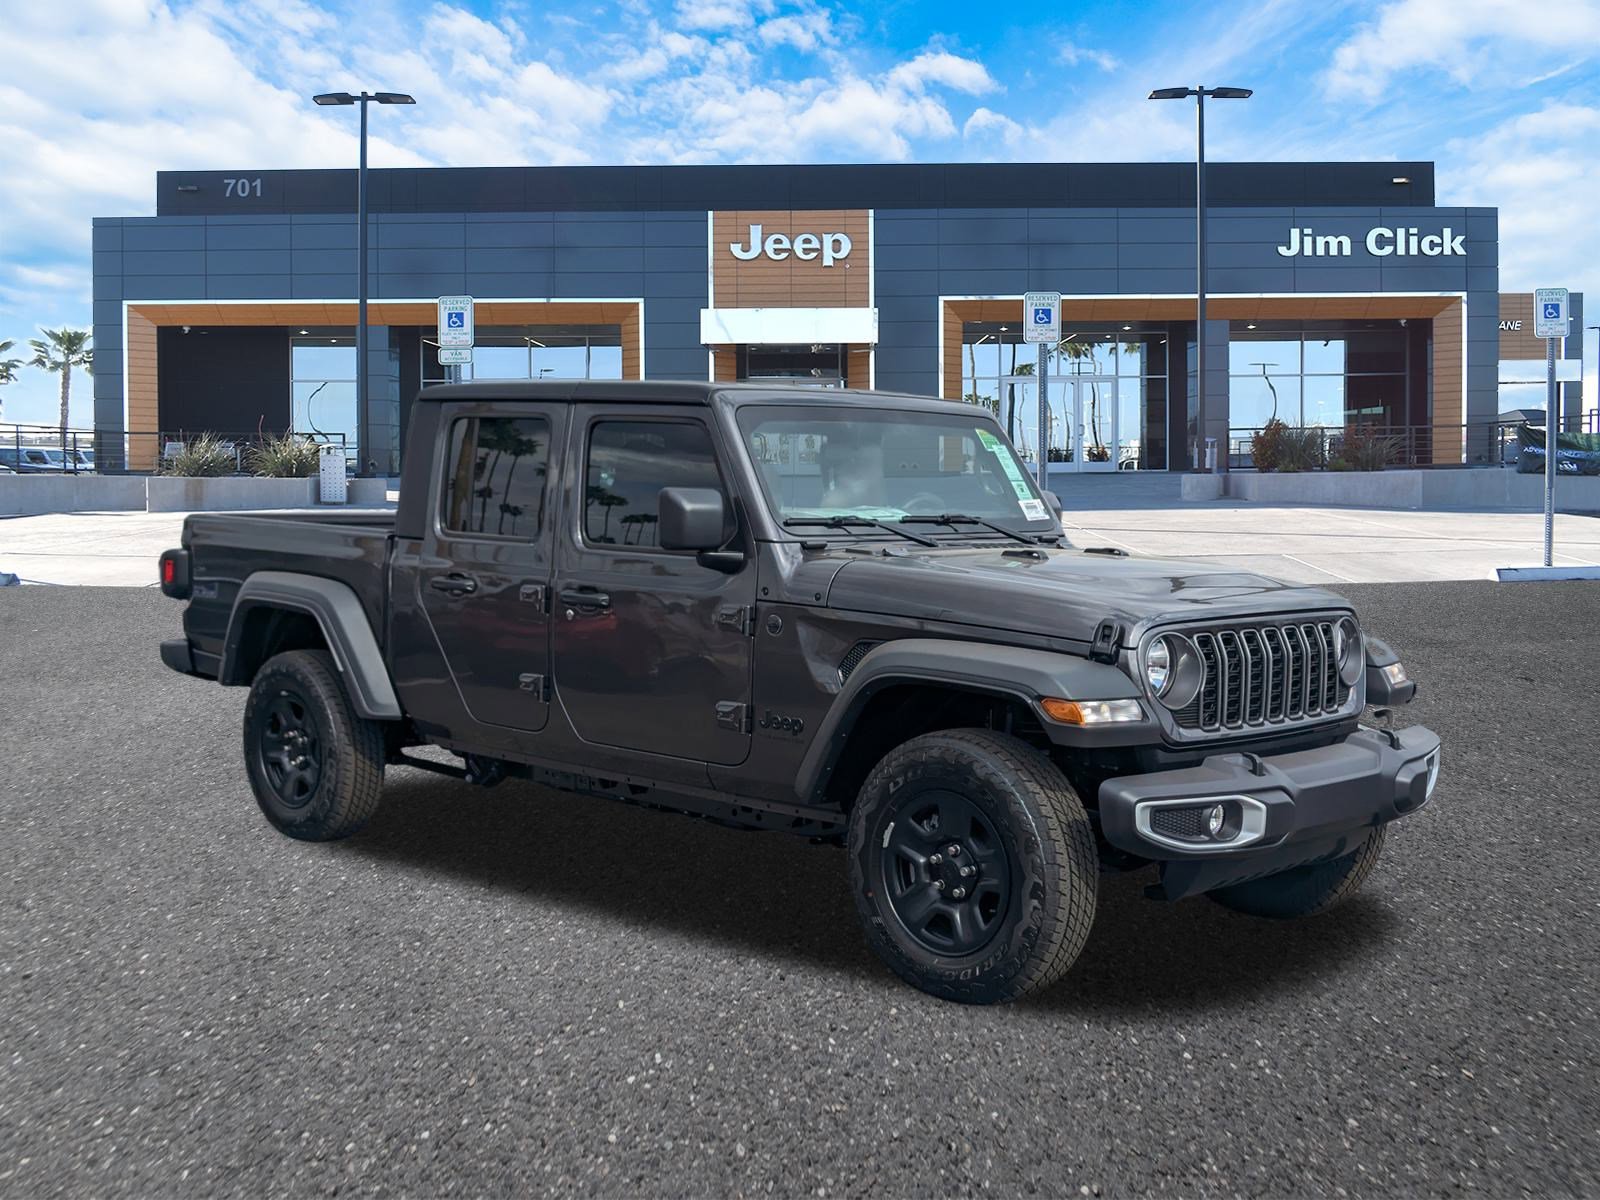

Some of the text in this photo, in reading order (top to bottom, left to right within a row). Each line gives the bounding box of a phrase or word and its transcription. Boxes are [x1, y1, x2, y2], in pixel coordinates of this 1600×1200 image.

[223, 178, 262, 197] 701
[730, 224, 852, 267] Jeep
[1277, 227, 1467, 257] Jim Click
[1499, 320, 1522, 330] ANE
[760, 709, 805, 736] Jeep
